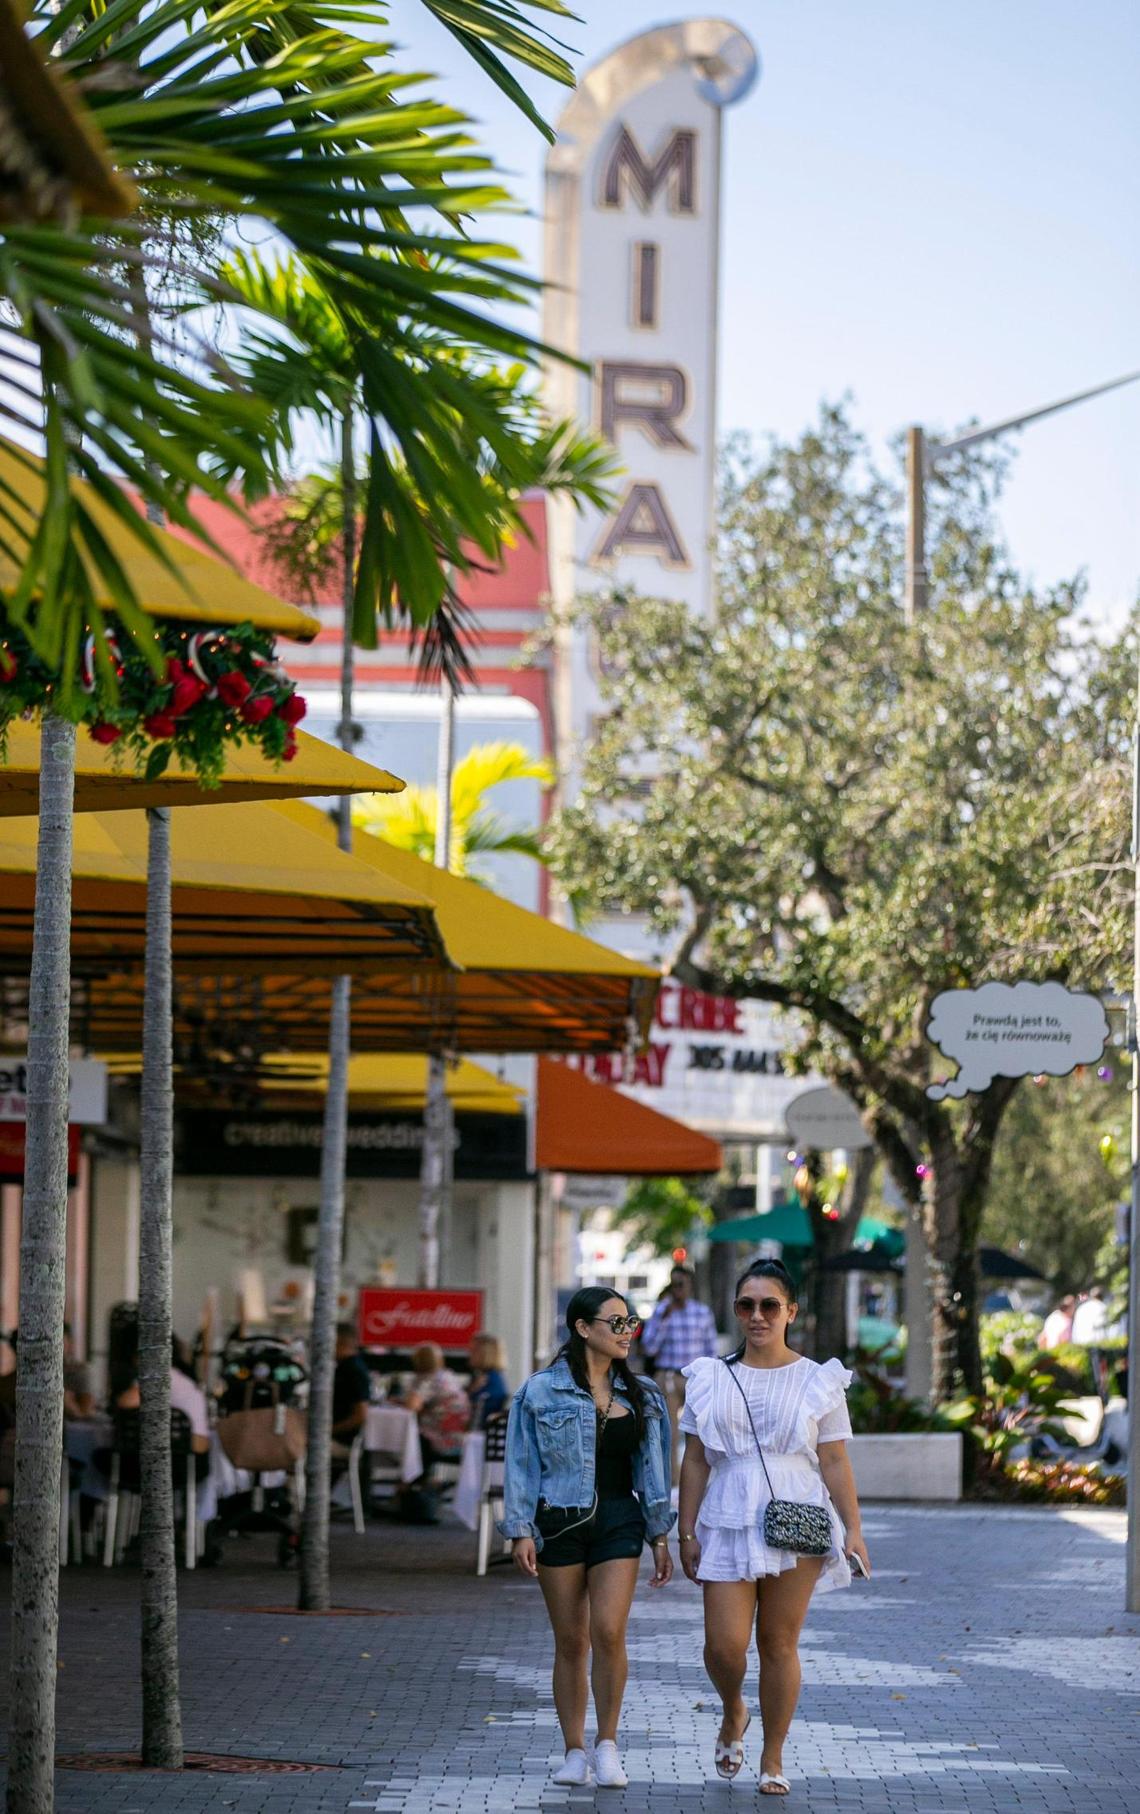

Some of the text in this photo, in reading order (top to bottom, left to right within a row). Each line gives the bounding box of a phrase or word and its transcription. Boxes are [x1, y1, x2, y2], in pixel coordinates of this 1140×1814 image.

[1020, 1015, 1042, 1029] jest
[1045, 1015, 1062, 1028] to,
[345, 1121, 462, 1149] weddins
